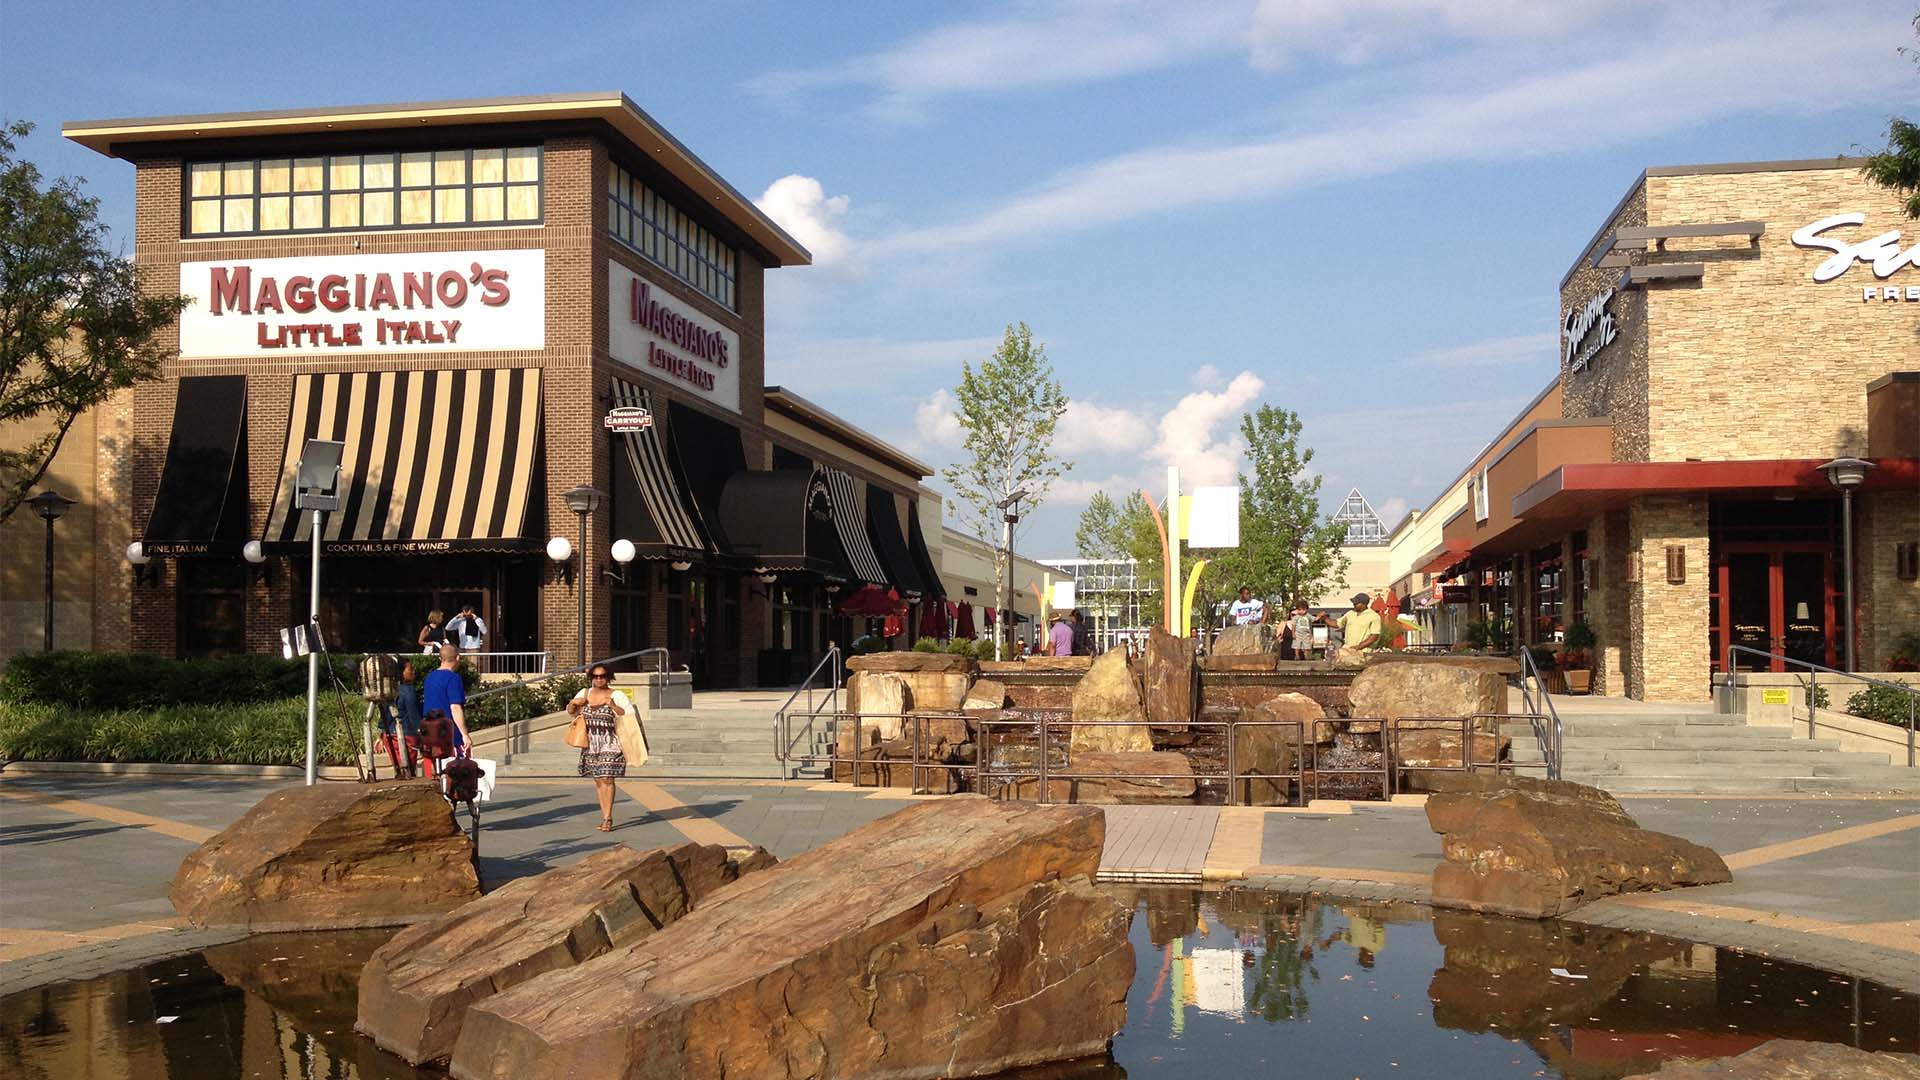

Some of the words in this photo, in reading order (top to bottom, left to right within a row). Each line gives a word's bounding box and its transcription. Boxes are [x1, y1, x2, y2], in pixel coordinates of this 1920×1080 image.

[210, 261, 511, 315] MAGGIANO'S
[257, 321, 363, 348] LITTLE
[376, 317, 462, 345] ITALY
[631, 277, 729, 368] MAGGIANO'S
[648, 341, 689, 380] LITTLE
[688, 360, 715, 391] ITALY
[606, 417, 650, 425] CARRYOUT
[171, 544, 208, 553] ITALIAN
[326, 543, 382, 552] COCKTAILS
[383, 543, 391, 552] &
[392, 543, 416, 551] FINE
[417, 542, 450, 550] WINES
